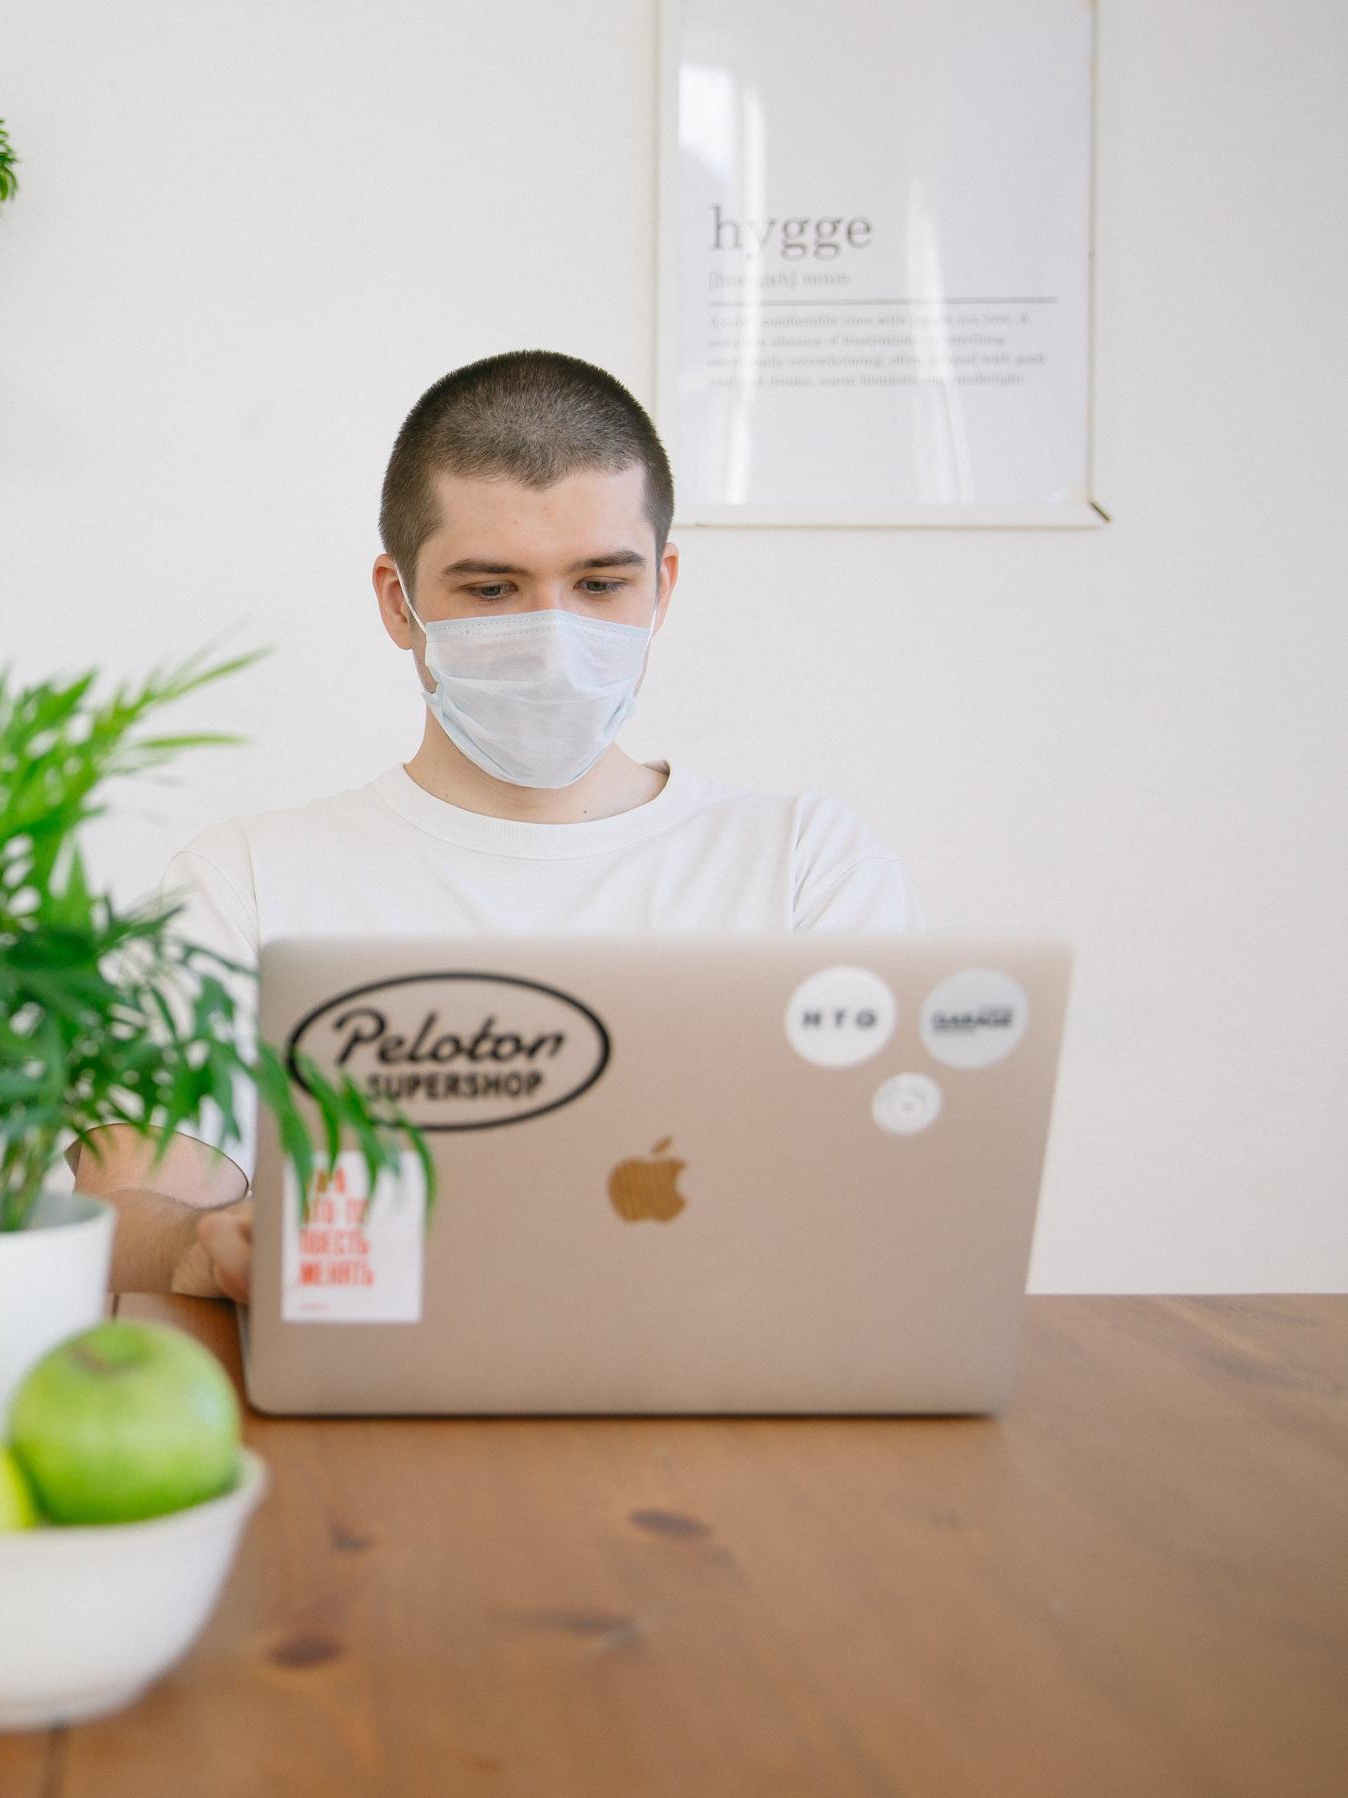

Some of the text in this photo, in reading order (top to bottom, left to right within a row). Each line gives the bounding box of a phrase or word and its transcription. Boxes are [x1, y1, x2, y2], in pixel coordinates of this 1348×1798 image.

[709, 204, 873, 261] hygge
[332, 1007, 565, 1066] Peloton
[367, 1070, 544, 1101] SUPERSHOP
[300, 1261, 377, 1288] МЕНЯТЬ
